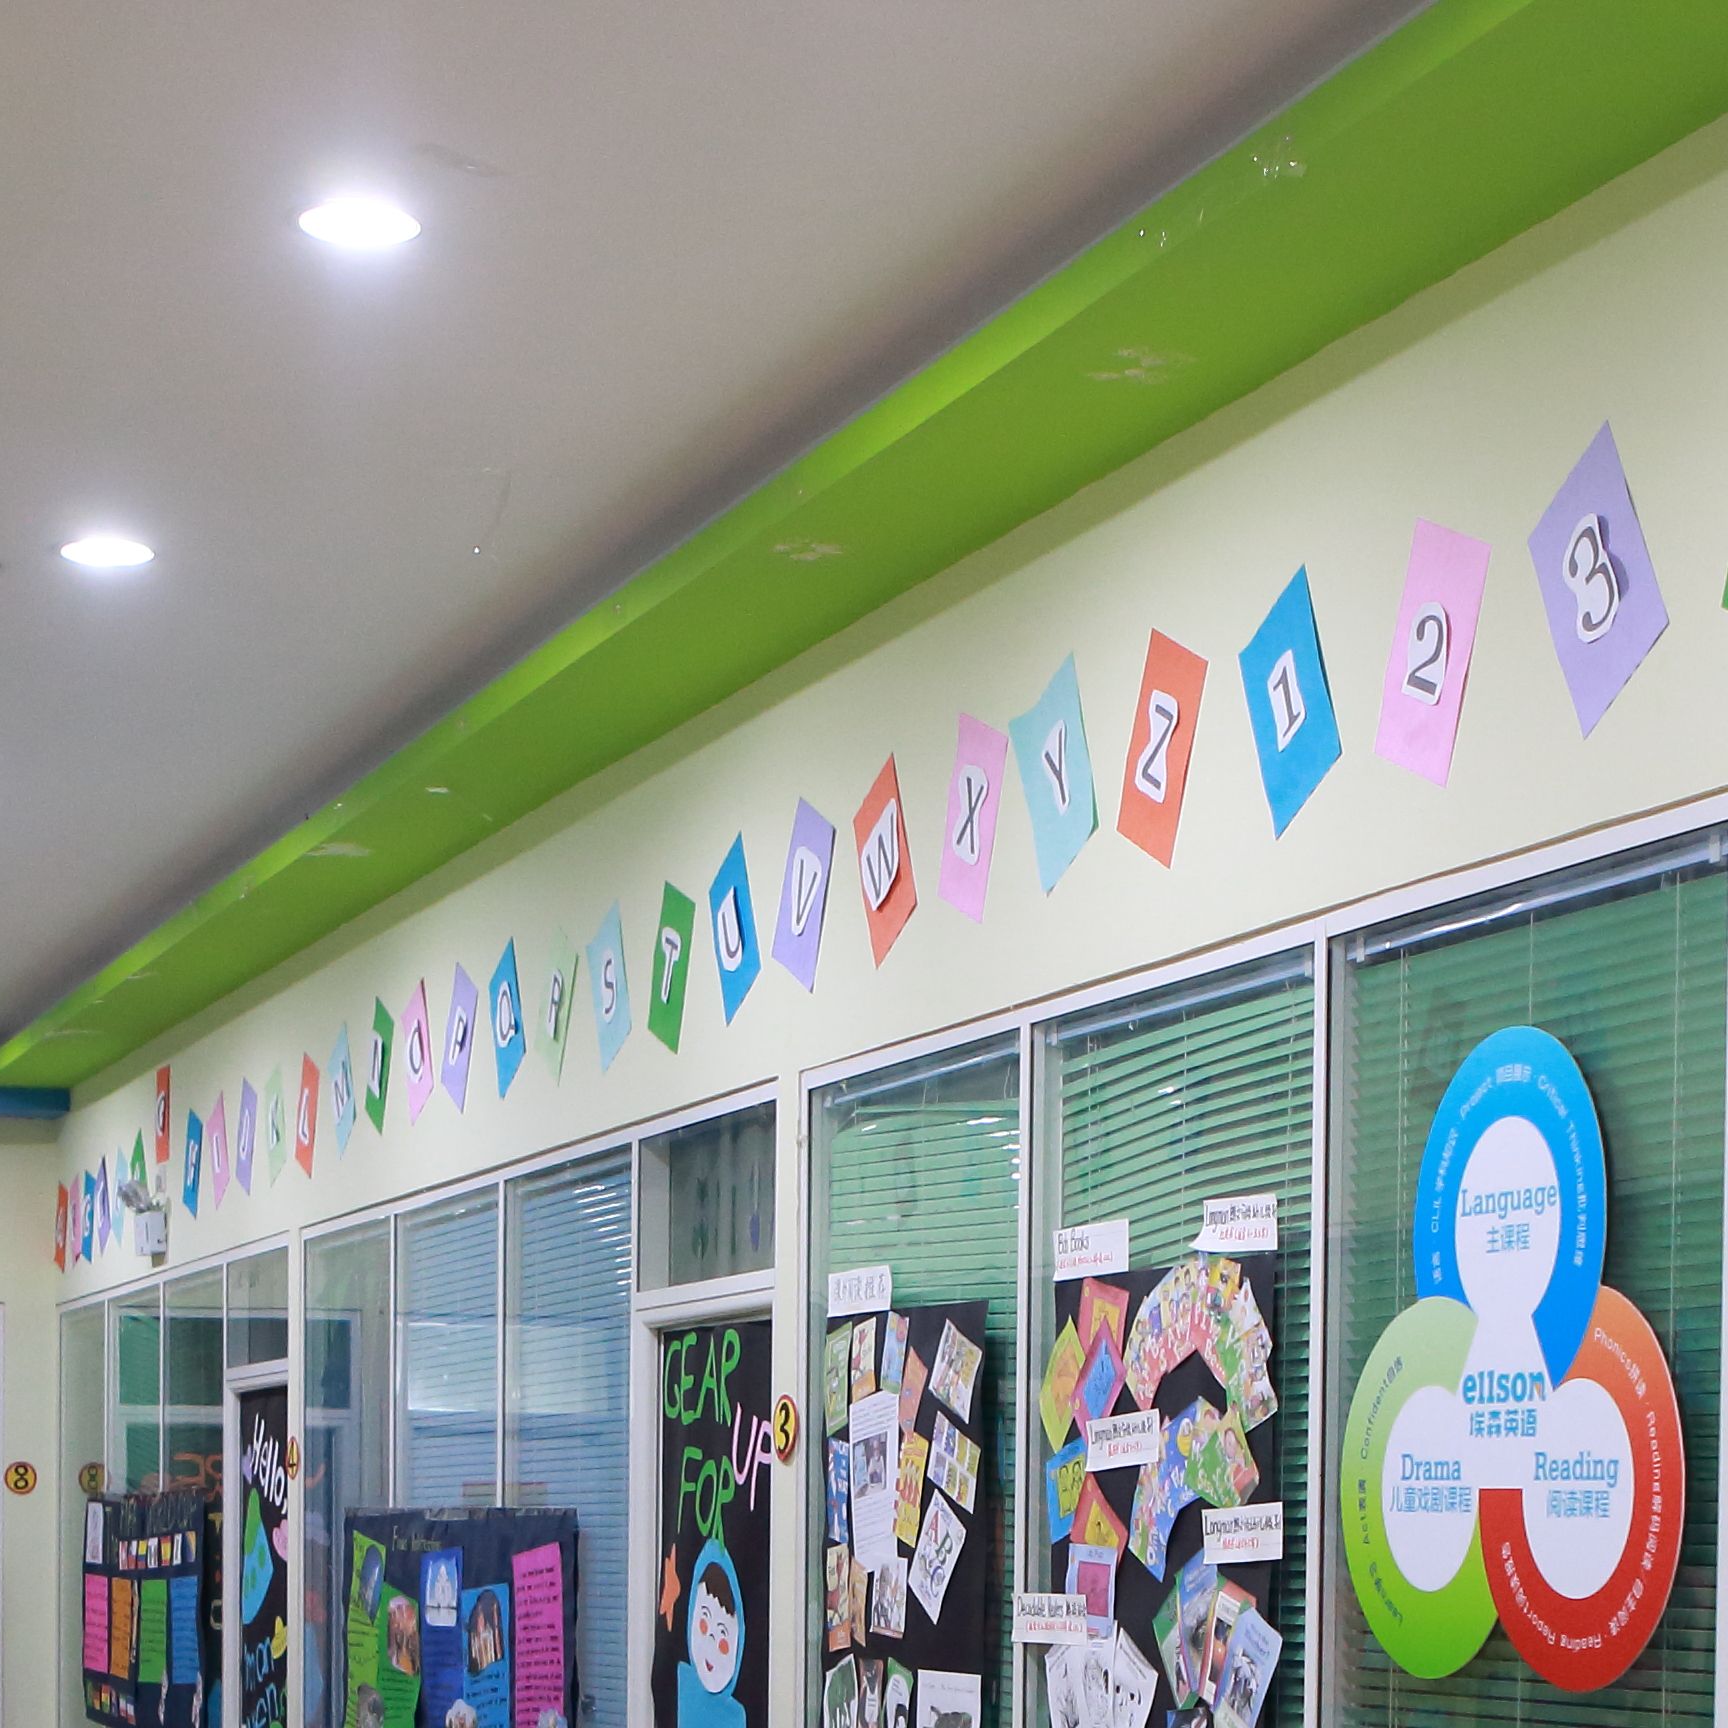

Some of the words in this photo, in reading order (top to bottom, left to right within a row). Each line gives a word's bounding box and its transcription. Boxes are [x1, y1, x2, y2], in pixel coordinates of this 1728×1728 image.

[1566, 524, 1617, 637] 3
[1408, 614, 1443, 696] 2
[1271, 666, 1301, 736] 1
[1044, 726, 1067, 806] Y
[1142, 703, 1173, 791] Z
[957, 775, 984, 856] X
[795, 857, 817, 919] V
[867, 816, 897, 905] W
[604, 958, 615, 1015] S
[661, 936, 679, 1001] T
[499, 991, 515, 1042] Q
[550, 975, 562, 1034] R
[1460, 1184, 1558, 1219] Language
[1485, 1223, 1530, 1254] 主课程
[664, 1328, 741, 1428] GEAR
[731, 1402, 772, 1512] UP
[778, 1402, 790, 1451] 3
[14, 1465, 30, 1490] 8
[677, 1446, 735, 1550] FOR
[1401, 1454, 1462, 1482] Drama
[1534, 1452, 1619, 1489] Reading
[1390, 1486, 1472, 1515] 儿童戏剧课程
[1546, 1490, 1611, 1519] 阅读课程
